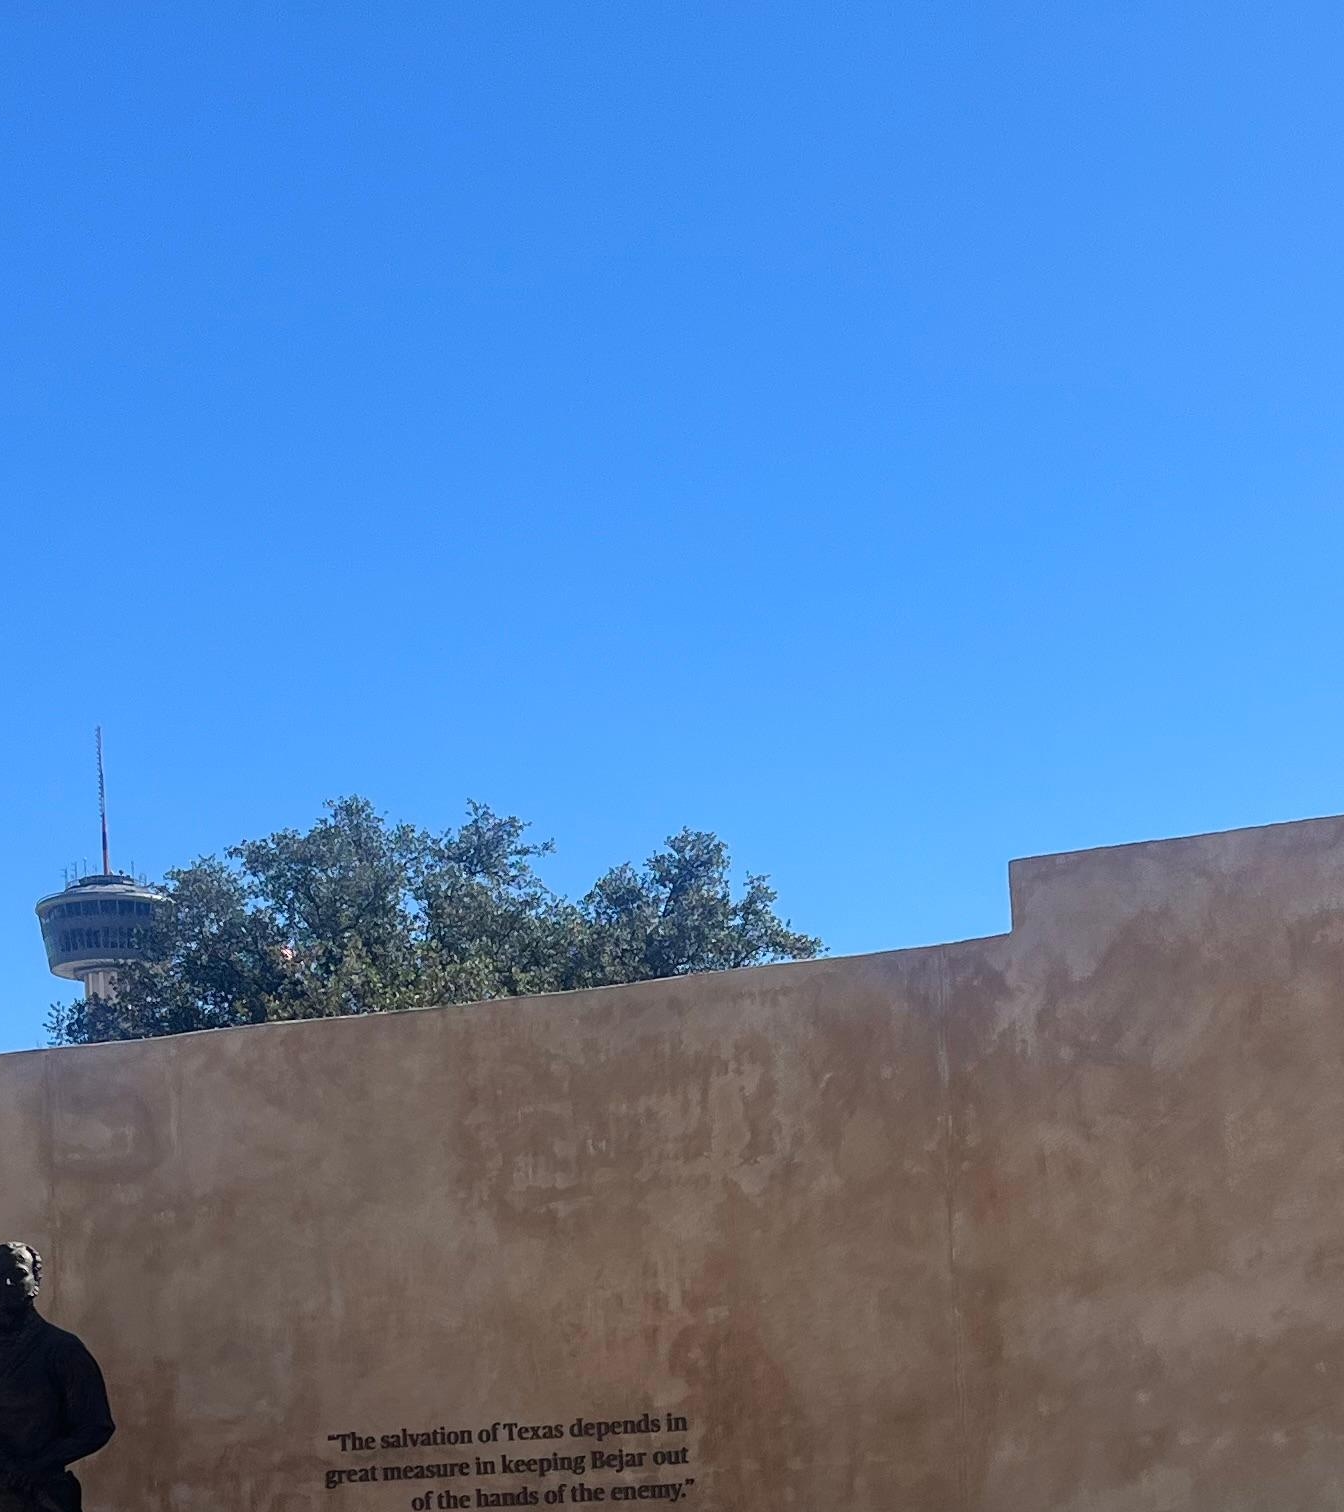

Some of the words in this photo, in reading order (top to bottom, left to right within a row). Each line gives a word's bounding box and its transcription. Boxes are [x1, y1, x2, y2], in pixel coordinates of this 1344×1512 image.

[380, 1426, 473, 1449] salvation
[478, 1422, 501, 1443] of
[504, 1422, 564, 1441] Texas
[569, 1413, 661, 1441] depends
[666, 1412, 688, 1432] in
[325, 1465, 379, 1489] great
[382, 1461, 471, 1481] measure
[475, 1456, 496, 1475] in
[501, 1452, 586, 1477] keeping
[591, 1448, 647, 1472] Bejar
[652, 1447, 689, 1465] out
[411, 1491, 434, 1511] of
[437, 1490, 472, 1510] the
[475, 1486, 539, 1508] hands
[544, 1483, 567, 1505] of
[571, 1482, 605, 1502] the
